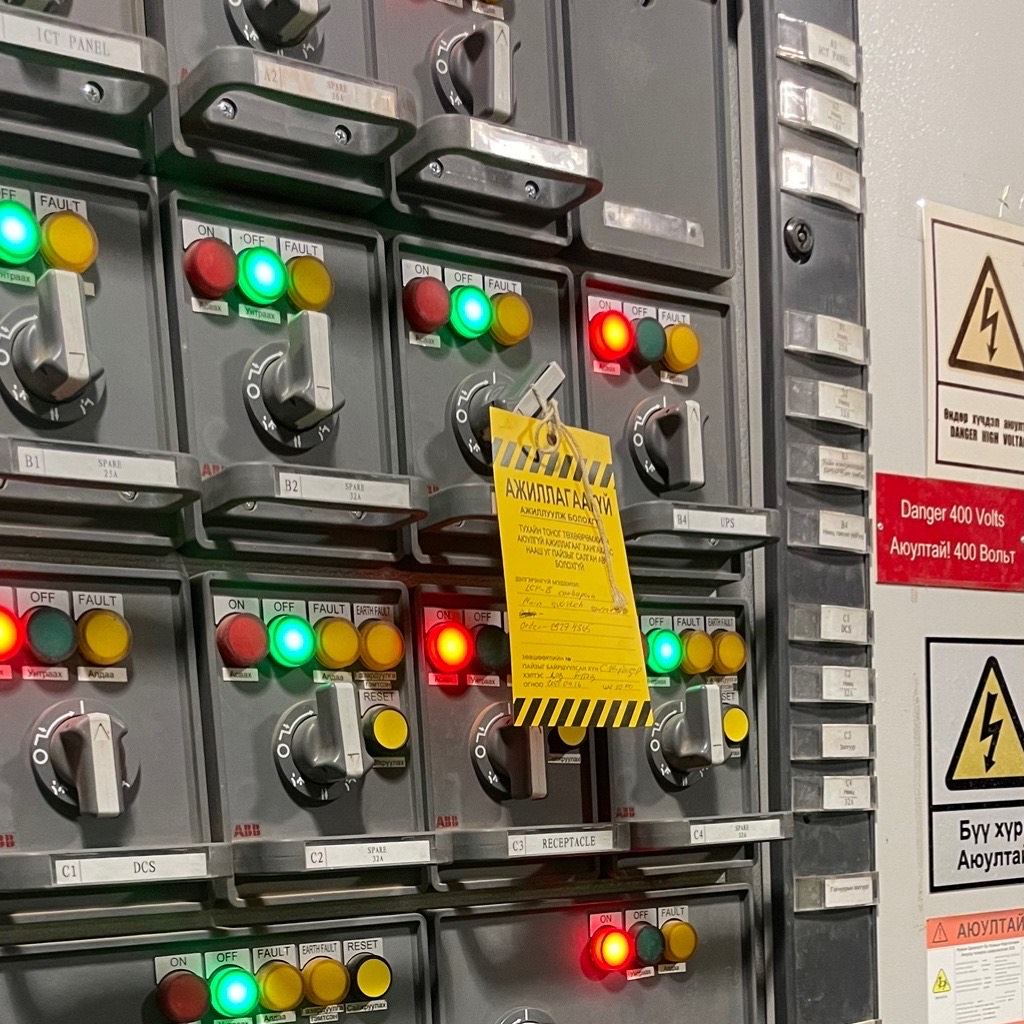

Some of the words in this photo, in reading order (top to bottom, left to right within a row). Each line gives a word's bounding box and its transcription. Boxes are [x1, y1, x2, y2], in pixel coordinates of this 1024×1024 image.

[36, 27, 60, 46] ICT
[69, 35, 111, 57] PANEL
[264, 69, 278, 83] A2
[326, 81, 348, 93] SPARE
[0, 189, 17, 200] FF
[40, 195, 81, 213] FAULT
[198, 225, 215, 238] ON
[243, 233, 266, 247] OFF
[284, 241, 318, 256] FAULT
[0, 270, 31, 284] нтраах
[414, 264, 430, 276] ON
[454, 273, 473, 284] OFF
[488, 279, 517, 293] FAULT
[598, 299, 611, 310] ON
[631, 306, 648, 317] OFF
[661, 311, 687, 325] FAULT
[943, 407, 968, 425] Өндөр
[972, 414, 1000, 430] хүчдэл
[950, 426, 978, 441] DANGER
[981, 430, 999, 445] HIGH
[1003, 433, 1024, 448] VOLTA
[25, 454, 40, 469] B1
[98, 459, 122, 470] SPARE
[104, 469, 119, 478] 25A
[284, 479, 298, 492] B2
[344, 482, 365, 492] SPARE
[349, 491, 362, 500] 32A
[901, 499, 947, 526] Danger
[949, 505, 973, 525] 400
[975, 507, 1005, 528] Volts
[677, 514, 687, 525] B4
[720, 517, 735, 528] UPS
[890, 536, 950, 561] Аюултай!
[953, 543, 977, 561] 400
[979, 545, 1016, 565] Вольт
[30, 591, 55, 603] OFF
[78, 594, 117, 607] FAULT
[228, 599, 245, 610] ON
[274, 601, 295, 612] OFF
[313, 603, 346, 615] FAULT
[356, 605, 373, 616] EARTH
[374, 606, 391, 617] FAULT
[436, 610, 450, 620] ON
[473, 612, 492, 622] OFF
[648, 617, 664, 627] OFF
[676, 617, 701, 627] FAULT
[841, 624, 852, 634] DCS
[364, 691, 395, 702] RESET
[721, 691, 736, 701] SET
[615, 806, 635, 818] ABB
[436, 815, 459, 829] ABB
[233, 823, 261, 838] ABB
[693, 829, 704, 841] C4
[0, 834, 15, 848] BB
[512, 839, 525, 852] C3
[542, 835, 596, 850] RECEPTACLE
[367, 846, 387, 855] SPARE
[310, 851, 324, 865] C2
[371, 855, 384, 863] 32A
[62, 865, 77, 879] C1
[133, 860, 157, 875] DCS
[600, 915, 612, 924] ON
[633, 910, 649, 920] OFF
[661, 907, 685, 917] FAULT
[170, 957, 187, 967] ON
[216, 951, 238, 963] OFF
[257, 946, 290, 959] FAULT
[302, 943, 319, 955] EARTH
[320, 942, 337, 954] FAULT
[347, 939, 378, 951] RESET
